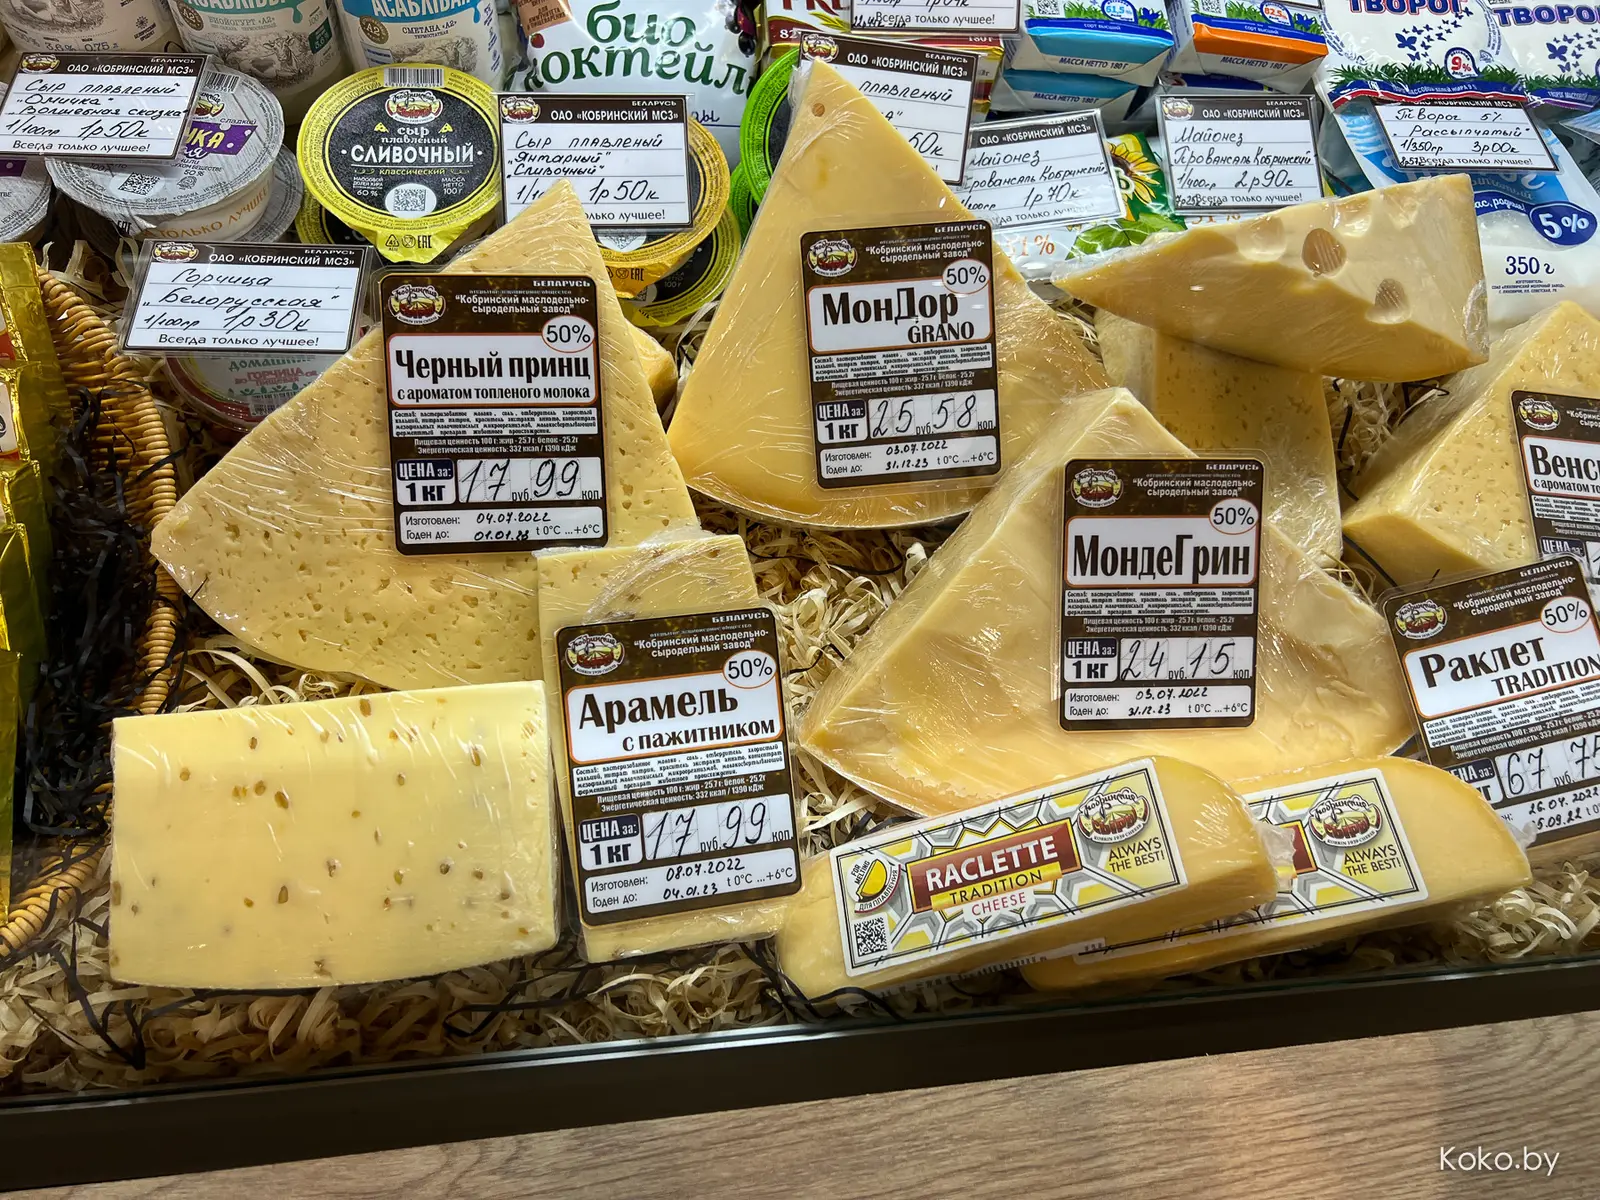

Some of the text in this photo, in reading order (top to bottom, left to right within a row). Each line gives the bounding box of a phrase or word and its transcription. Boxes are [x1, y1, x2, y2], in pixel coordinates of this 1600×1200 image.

[915, 15, 950, 24] только
[953, 14, 995, 26] лучшее!
[1494, 5, 1600, 25] ТВОРО
[402, 25, 441, 35] СМЕТАНА
[586, 0, 697, 47] био
[67, 63, 194, 75] ОАО «КОБРИНСКИЙ МСЗ»
[1059, 57, 1108, 68] МАССА НЕТТО
[1221, 56, 1268, 68] МАССА НЕТТО
[24, 79, 66, 92] Сыр
[550, 110, 574, 122] ОАО
[652, 110, 679, 122] МСЗ»
[1202, 108, 1305, 119] ОАО «КОБРИНСКИЙ МСЗ»
[380, 134, 449, 145] плавленый
[397, 126, 430, 138] сыр
[515, 130, 552, 149] Сыр
[12, 140, 151, 153] Всегда только лучшее!
[980, 134, 999, 146] ОАО
[351, 142, 474, 164] СЛИВОЧНЫЙ
[379, 168, 446, 176] классический
[584, 211, 615, 221] олько
[1015, 211, 1050, 222] только
[934, 225, 986, 233] БЕЛАРУСЬ
[924, 240, 985, 251] маслодельно-
[238, 253, 321, 265] «КОБРИНСКИЙ
[880, 251, 941, 263] сыродельный
[1505, 255, 1540, 275] 350
[171, 267, 273, 288] Горчица
[946, 265, 986, 286] 50%
[522, 295, 589, 306] маслодельно-
[822, 287, 958, 326] МонДор
[472, 304, 540, 314] сыродельный
[546, 324, 591, 343] 50%
[907, 321, 974, 344] GRANO
[158, 333, 319, 348] Всегда только лучшее!
[396, 350, 591, 384] Черный принц
[397, 387, 590, 402] с ароматом топленого молока
[819, 406, 864, 420] ЦЕНА за:
[873, 399, 914, 437] 25
[933, 394, 976, 430] 58
[825, 423, 860, 440] 1 кг
[825, 451, 872, 462] Изготовлен:
[1529, 444, 1600, 481] Венс
[399, 463, 452, 478] ЦЕНА за:
[826, 465, 848, 475] Годен
[850, 464, 863, 474] до:
[461, 459, 511, 502] 17
[534, 459, 580, 498] 99
[1194, 480, 1256, 488] маслодельно-
[1534, 479, 1589, 493] с ароматом
[406, 483, 446, 502] 1 кг
[1147, 488, 1210, 498] сыродельный
[406, 515, 461, 526] Изготовлен:
[1213, 507, 1255, 525] 50%
[406, 530, 432, 540] Годен
[435, 530, 450, 540] до:
[1073, 534, 1250, 584] МондеГрин
[1068, 641, 1115, 656] ЦЕНА за:
[1121, 640, 1235, 680] 24 15
[1419, 637, 1545, 689] Раклет
[1070, 693, 1120, 702] Изготовлен:
[579, 688, 738, 733] Арамель
[1070, 706, 1093, 716] Годен
[1096, 707, 1109, 716] до:
[638, 720, 775, 750] пажитником
[1507, 747, 1545, 795] 67
[597, 791, 631, 805] Пищевая
[631, 788, 665, 800] ценность
[601, 797, 659, 812] Энергетическая
[695, 791, 708, 800] 332
[1533, 808, 1583, 830] 5.09.22
[647, 802, 766, 859] 17 99
[1109, 837, 1162, 861] ALWAYS
[1344, 844, 1397, 865] ALWAYS
[925, 834, 1059, 892] RACLETTE
[1109, 850, 1165, 873] THE BEST!
[1346, 857, 1401, 877] THE BEST!
[666, 858, 745, 881] 08.07.2022
[851, 864, 861, 877] FOR
[854, 860, 870, 885] MELTING
[948, 868, 1044, 905] TRADITION
[592, 896, 619, 908] Годен
[971, 891, 1028, 917] CHEESE
